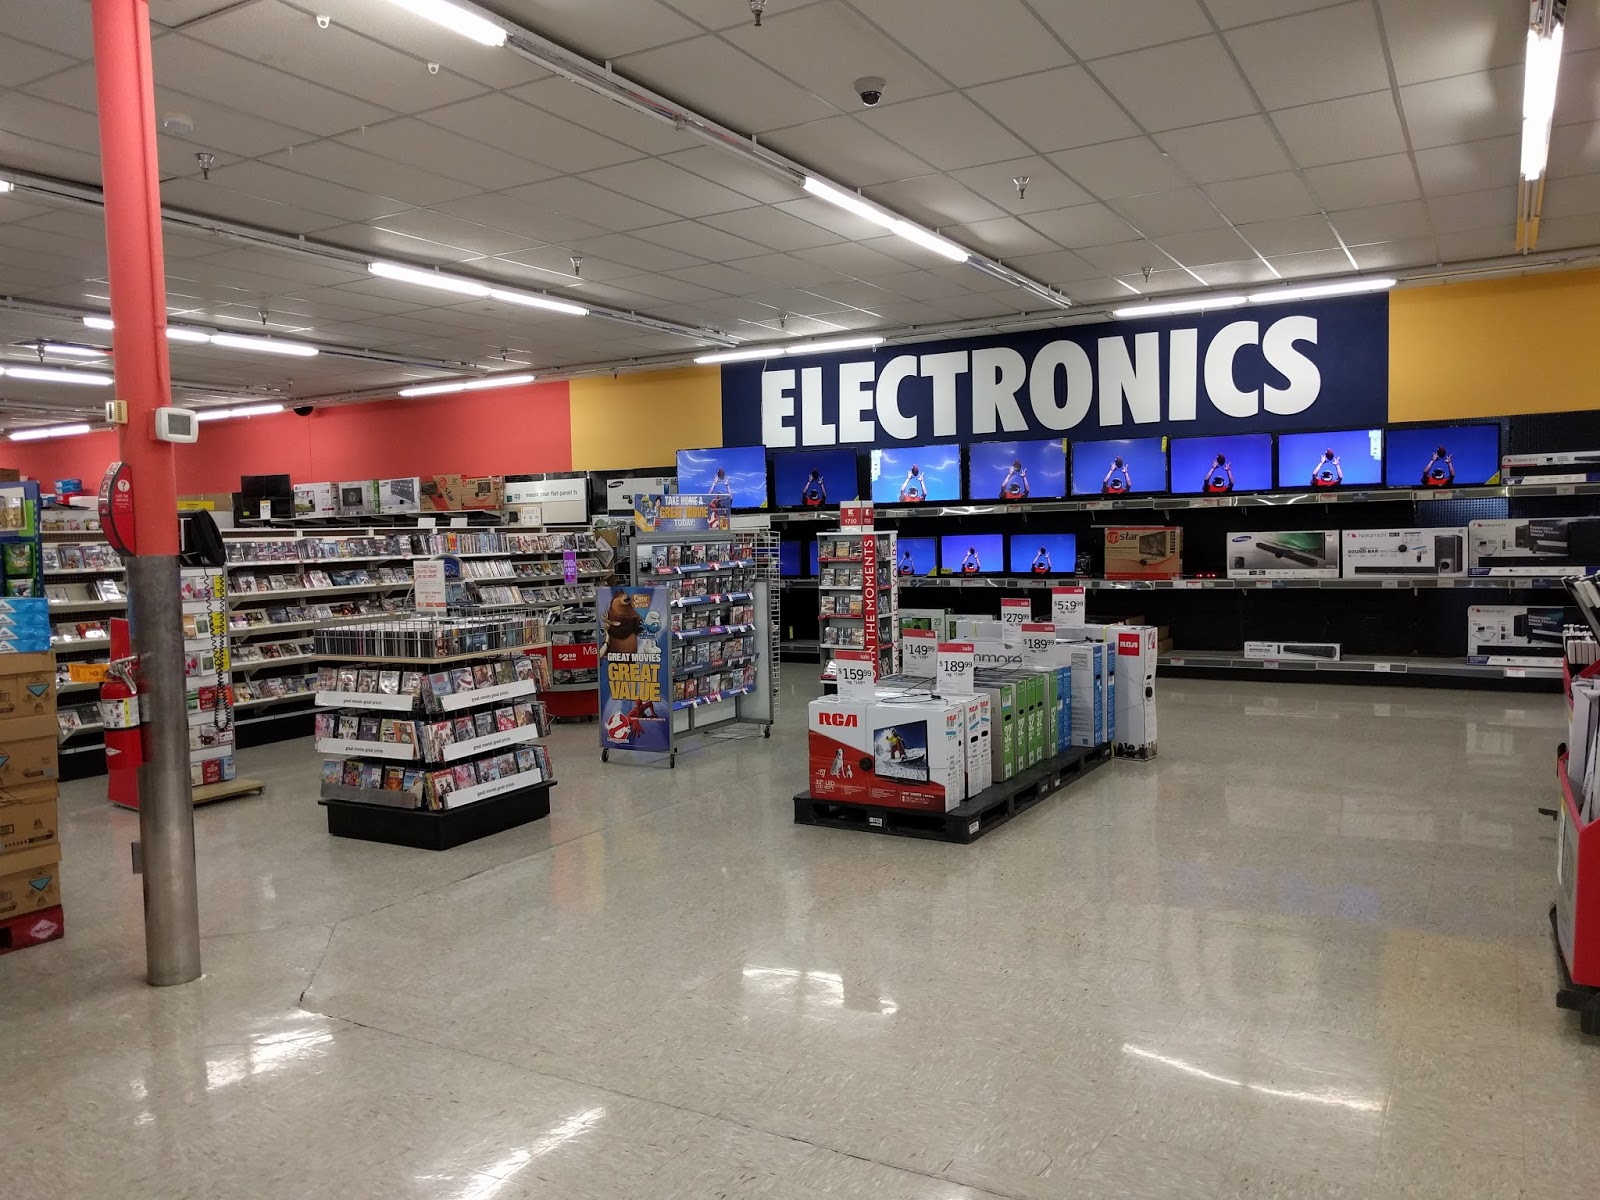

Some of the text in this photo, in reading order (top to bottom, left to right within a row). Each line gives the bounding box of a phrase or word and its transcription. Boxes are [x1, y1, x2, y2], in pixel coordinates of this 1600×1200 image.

[762, 315, 1321, 448] ELECTRONICS
[665, 496, 679, 506] TAKE
[681, 496, 698, 506] HOME
[660, 506, 708, 519] GREAT MOVIE
[674, 519, 696, 527] TODAY!
[863, 539, 876, 611] MOMENTS
[865, 614, 876, 641] THE
[582, 646, 598, 656] Ma
[1119, 641, 1138, 649] RCA
[607, 652, 661, 662] GREAT MOVIES
[973, 652, 1023, 663] nmore
[608, 663, 661, 682] GREAT
[609, 681, 661, 702] VALUE
[819, 712, 858, 728] RCA
